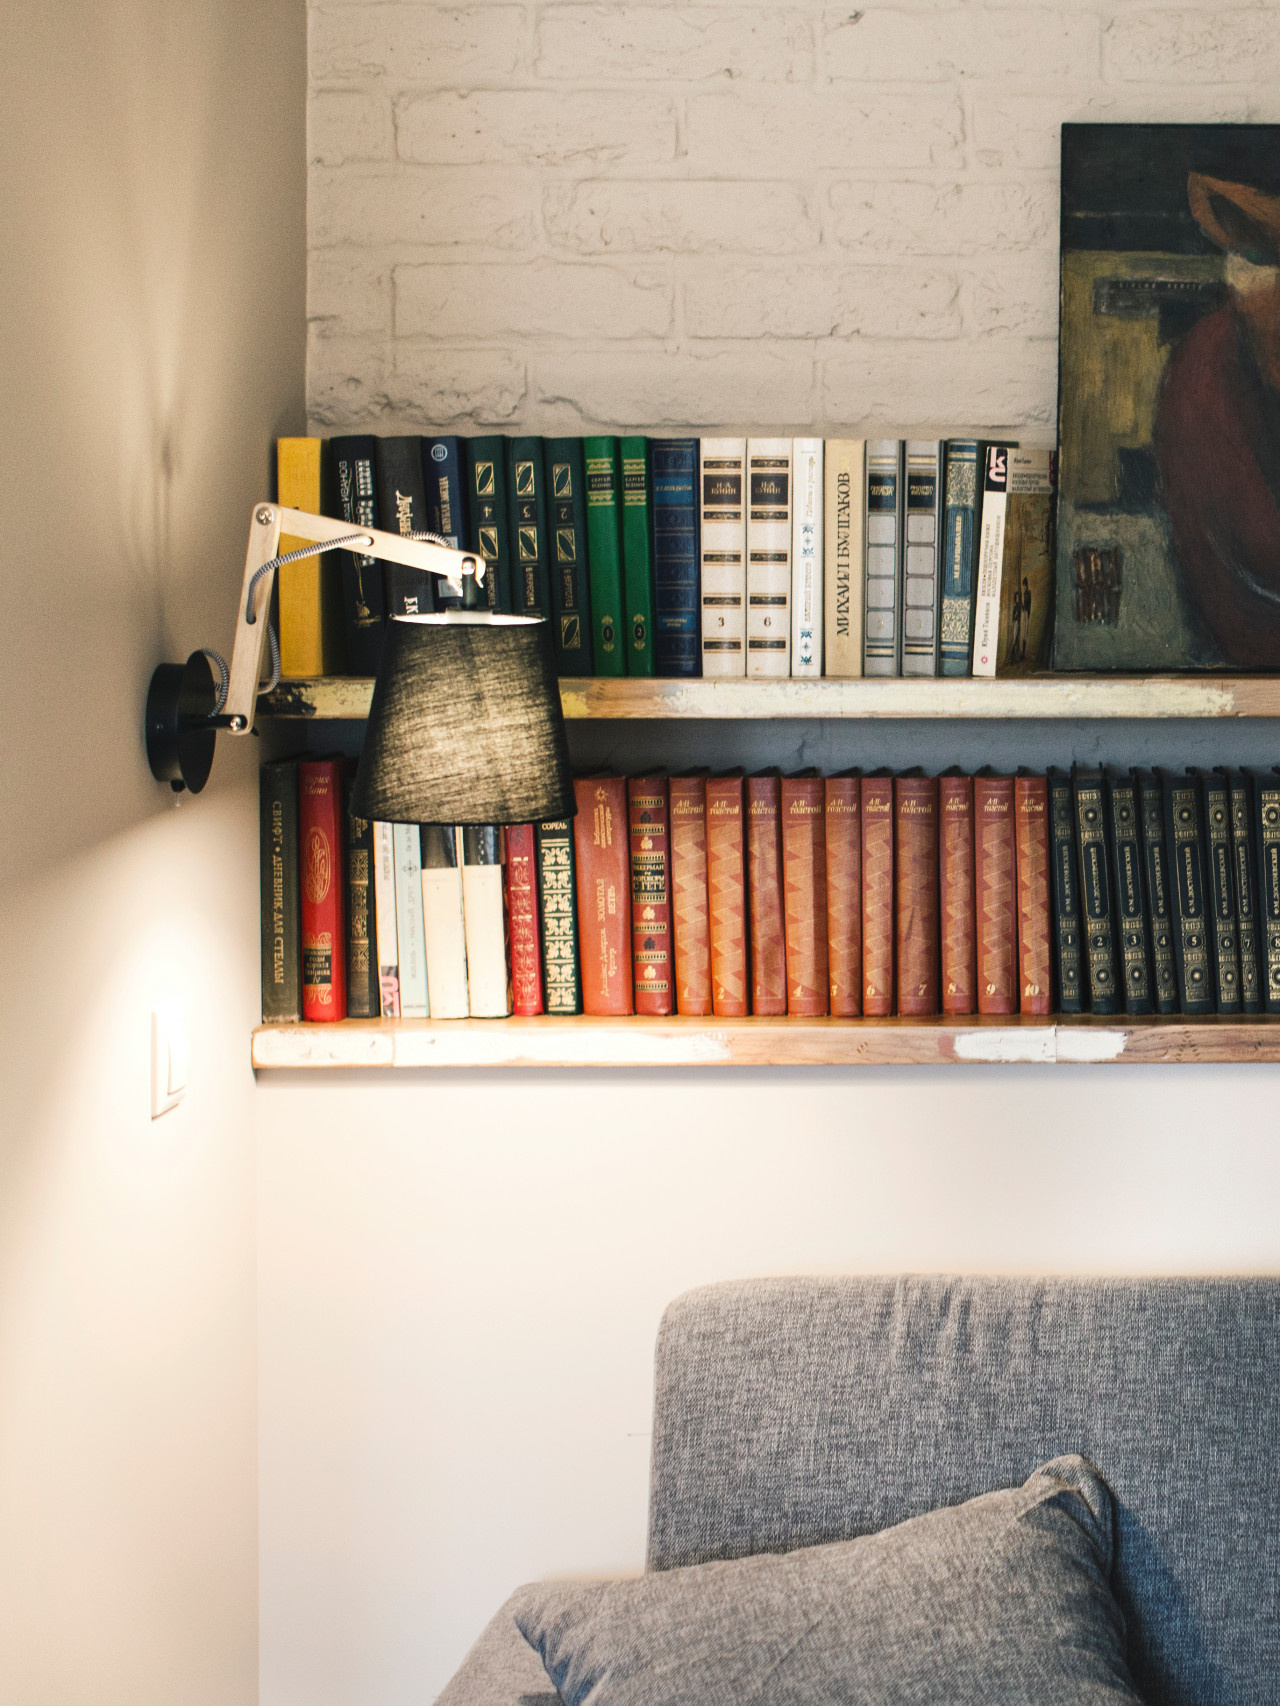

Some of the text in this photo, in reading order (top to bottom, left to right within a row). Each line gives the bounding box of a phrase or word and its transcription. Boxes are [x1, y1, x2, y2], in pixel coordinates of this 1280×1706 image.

[836, 473, 850, 637] МИХАИЛ БУЛГАКОВ
[718, 617, 725, 627] 3
[764, 616, 772, 627] 6
[636, 628, 642, 638] 2
[541, 822, 567, 831] СОРЕЛЬ
[641, 881, 665, 890] ГЕТЕ
[272, 801, 285, 984] СВИФТ ДНЕВНИК ДЛЯ СТЕЛЛЫ
[597, 879, 606, 922] ЗОЛОТАЯ
[608, 885, 616, 915] ВЕТВЬ
[1067, 935, 1072, 944] 1
[1097, 937, 1103, 946] 2
[1131, 936, 1137, 946] 3
[1160, 936, 1166, 946] 4
[1191, 936, 1198, 947] 5
[1224, 938, 1230, 948] 6
[1246, 939, 1251, 948] 7
[684, 987, 689, 997] 1
[718, 987, 725, 999] 2
[794, 985, 804, 997] 4
[831, 985, 838, 997] 5
[867, 985, 876, 996] 6
[919, 984, 928, 996] 7
[948, 984, 957, 994] 8
[986, 984, 996, 996] 9
[1025, 984, 1040, 997] 10
